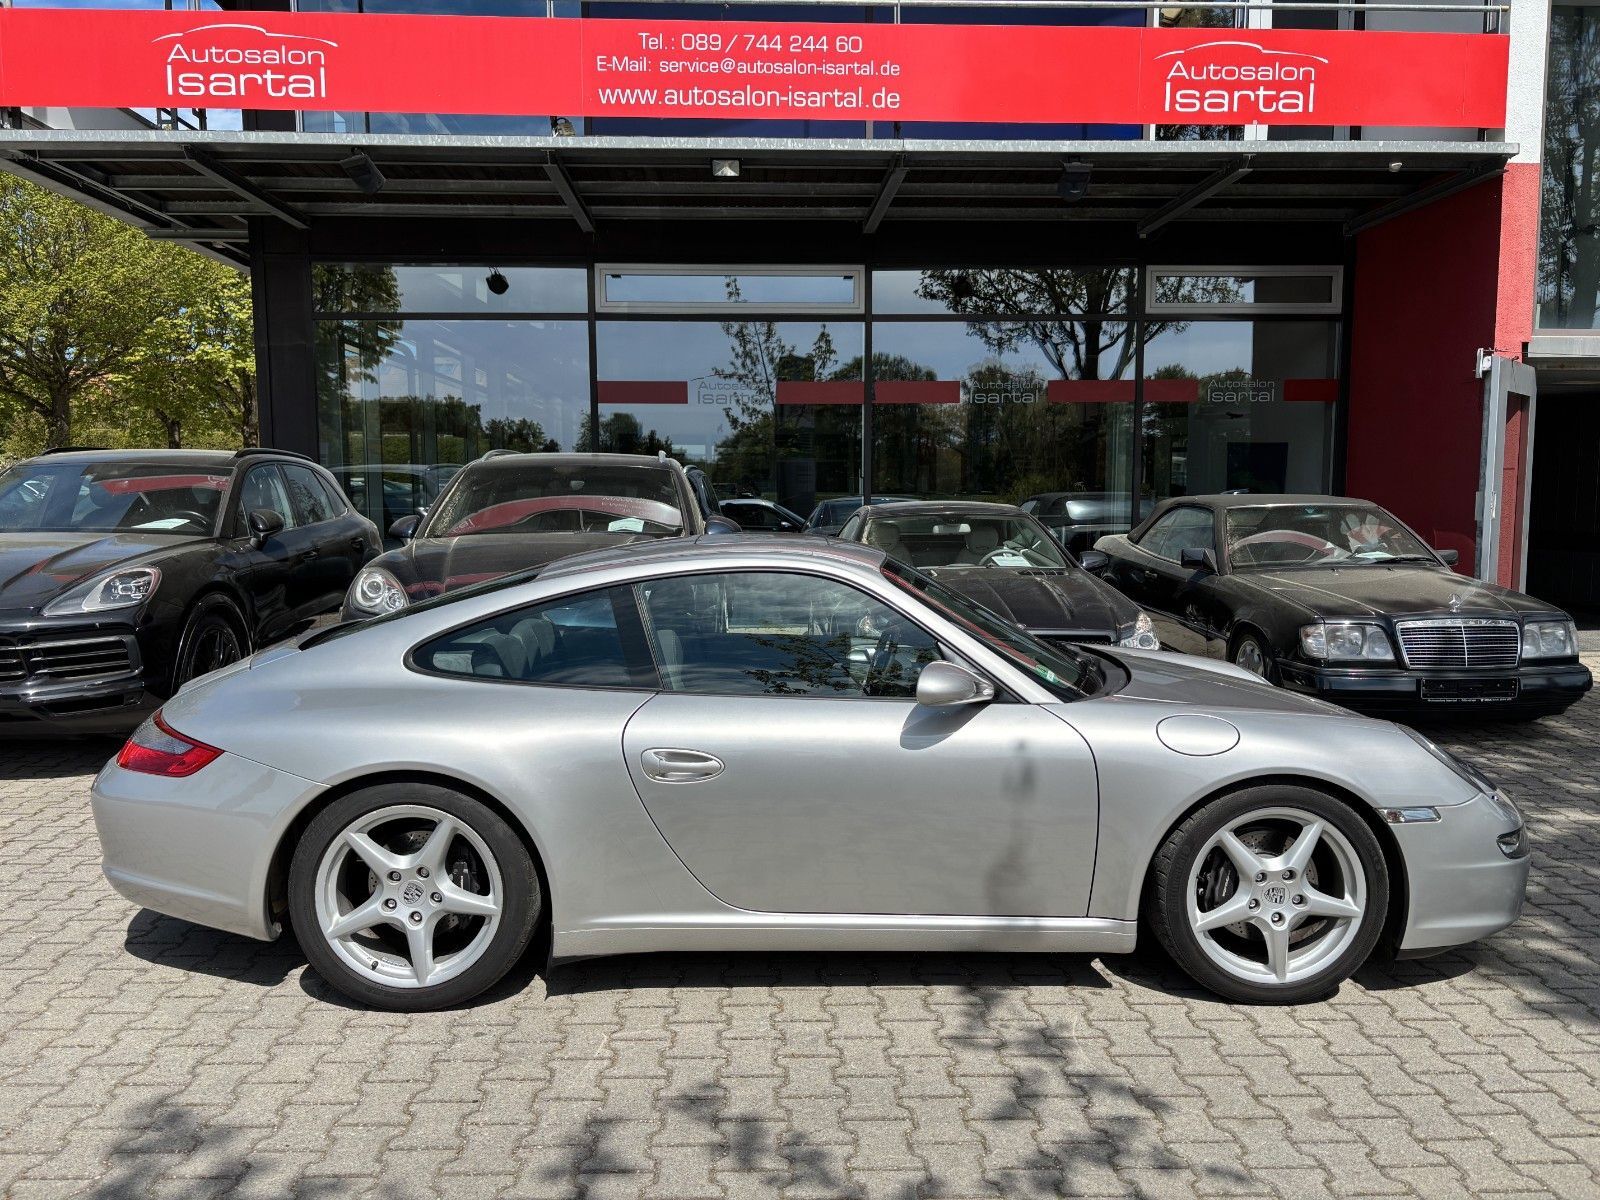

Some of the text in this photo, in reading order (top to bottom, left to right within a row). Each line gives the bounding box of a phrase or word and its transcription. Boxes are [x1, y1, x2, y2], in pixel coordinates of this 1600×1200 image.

[681, 33, 722, 51] 089
[725, 34, 739, 53] /
[743, 34, 783, 52] 744
[789, 35, 829, 53] 244
[835, 36, 863, 53] 60
[167, 43, 325, 65] Autosalon
[596, 56, 901, 76] E-Mail: service@autosalon-isartal.de
[1166, 60, 1315, 81] Autosalon
[166, 64, 326, 98] Isartal
[598, 85, 901, 109] www.autosalon-isartal.de
[1164, 81, 1315, 113] Isartal
[698, 381, 766, 390] Autosa
[972, 379, 1039, 390] Autosalon
[1208, 379, 1275, 388] Autosalon
[697, 390, 769, 404] Isart
[970, 390, 1039, 404] Isartal
[1207, 388, 1275, 402] Isartal
